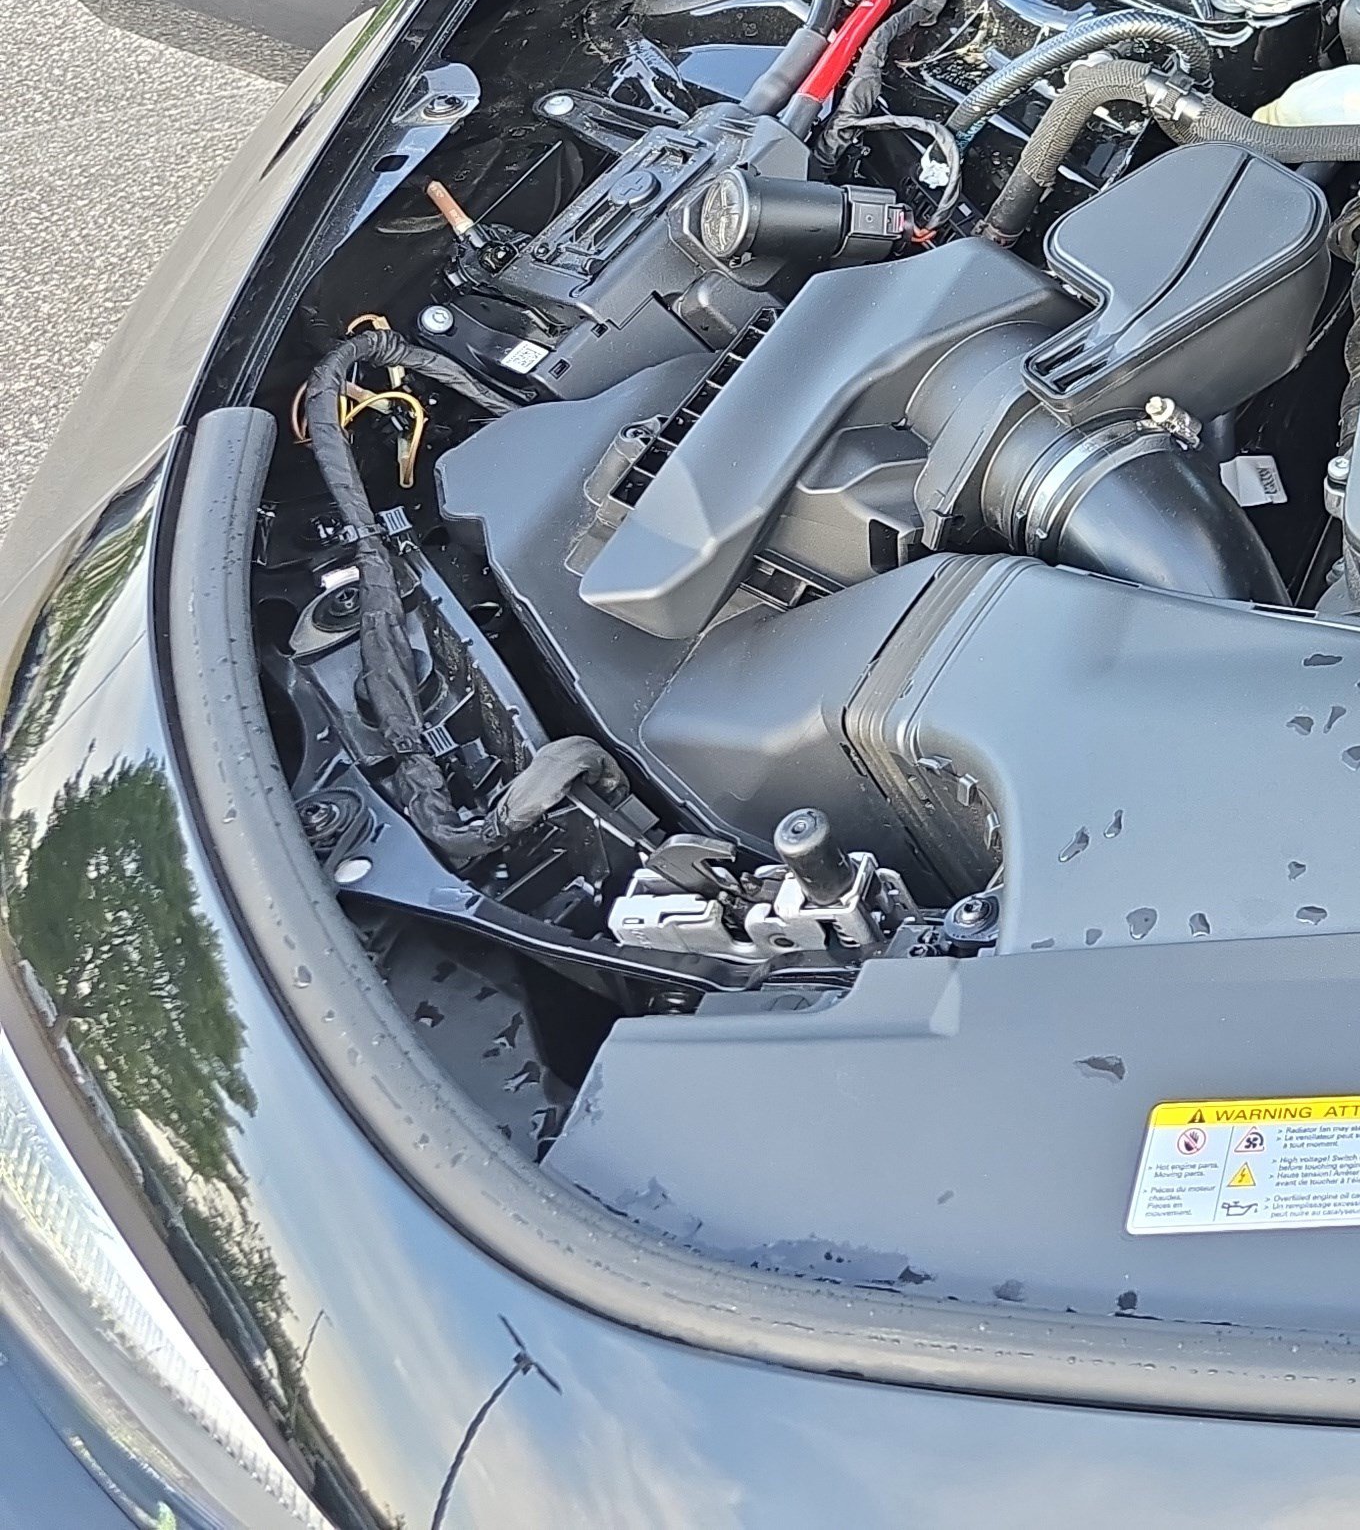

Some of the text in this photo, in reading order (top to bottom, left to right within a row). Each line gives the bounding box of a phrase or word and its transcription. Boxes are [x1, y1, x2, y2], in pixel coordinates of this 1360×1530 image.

[1215, 1107, 1312, 1121] WARNING
[1295, 1133, 1334, 1141] ventilateur
[1336, 1133, 1353, 1141] peut
[1300, 1155, 1331, 1164] voltage!
[1332, 1154, 1358, 1162] Switch
[1171, 1163, 1196, 1171] engine
[1278, 1163, 1302, 1171] before
[1304, 1162, 1338, 1171] touching
[1154, 1171, 1182, 1179] Moving
[1277, 1171, 1299, 1179] Haute
[1275, 1179, 1297, 1187] avant
[1273, 1194, 1311, 1202] Overfilled
[1312, 1193, 1338, 1202] engine
